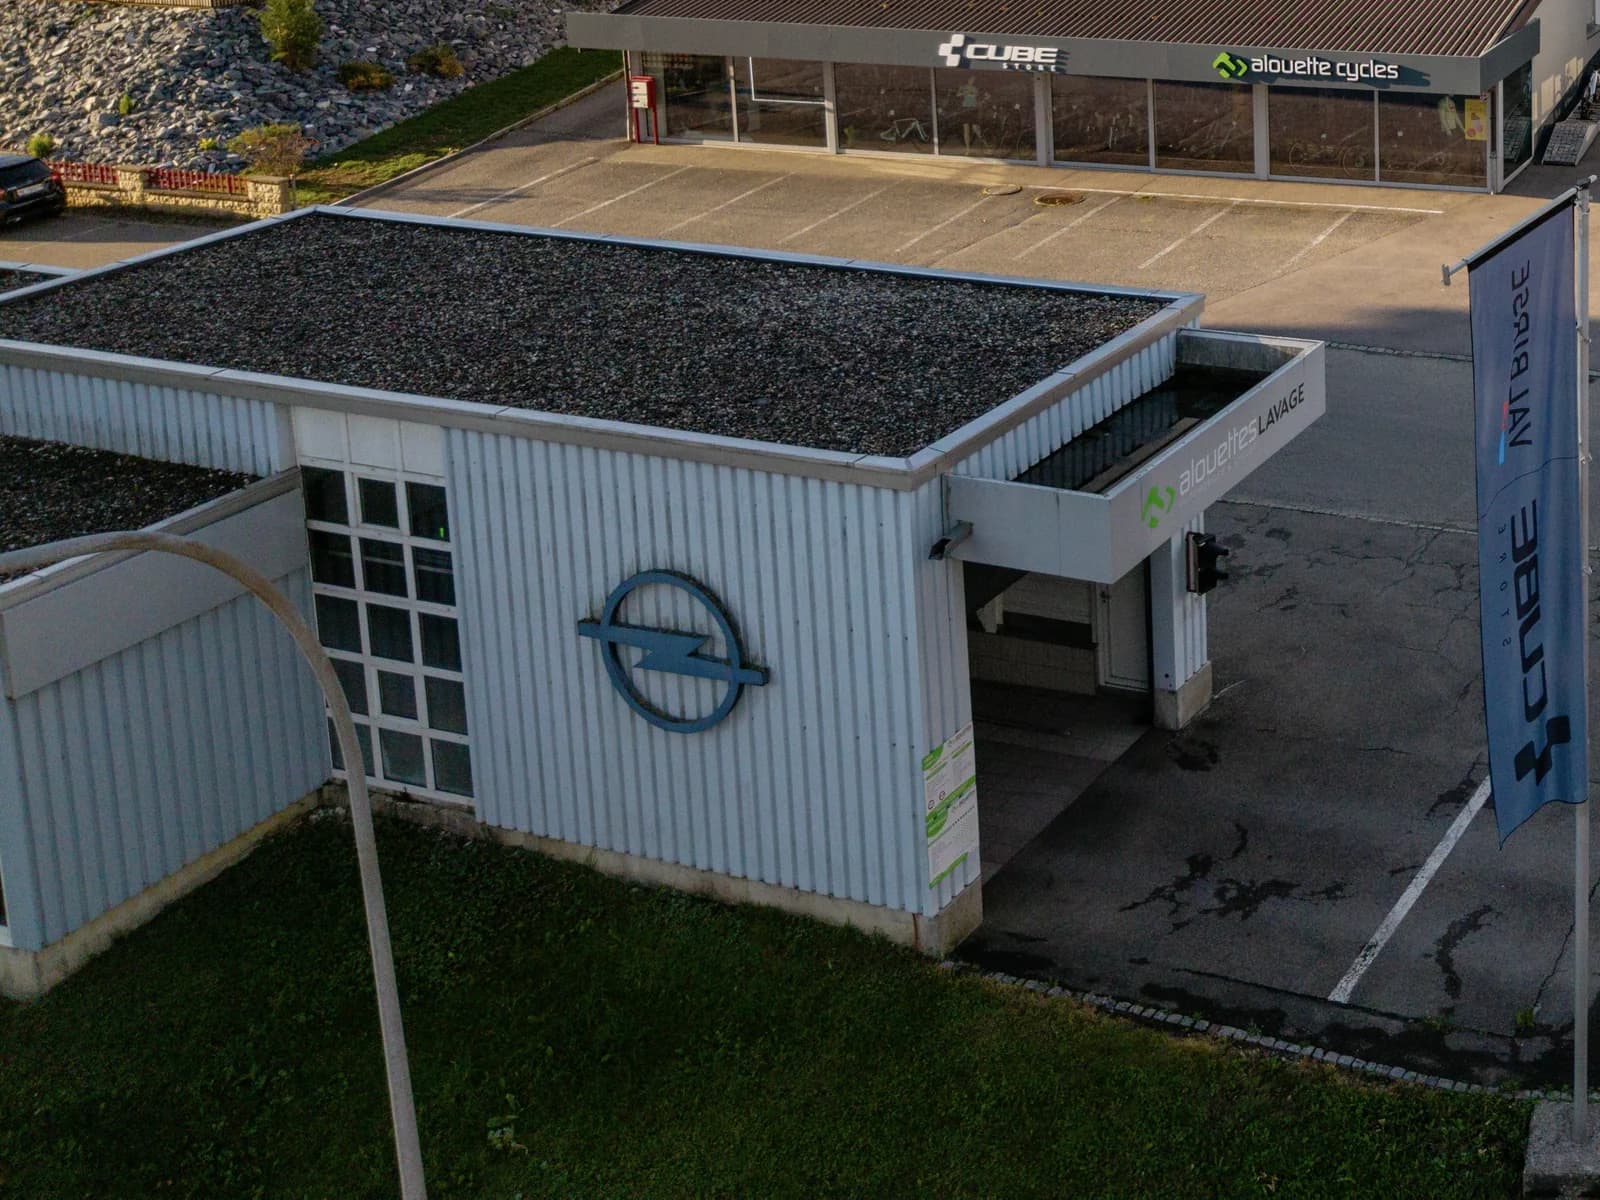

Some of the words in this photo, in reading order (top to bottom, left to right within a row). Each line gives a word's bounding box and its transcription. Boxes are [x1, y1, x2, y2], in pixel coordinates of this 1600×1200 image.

[966, 44, 1058, 63] CUBE
[1251, 55, 1330, 75] alouette
[1336, 60, 1399, 81] cycles
[1179, 418, 1257, 496] alouettes
[1258, 383, 1305, 436] LAVAGE
